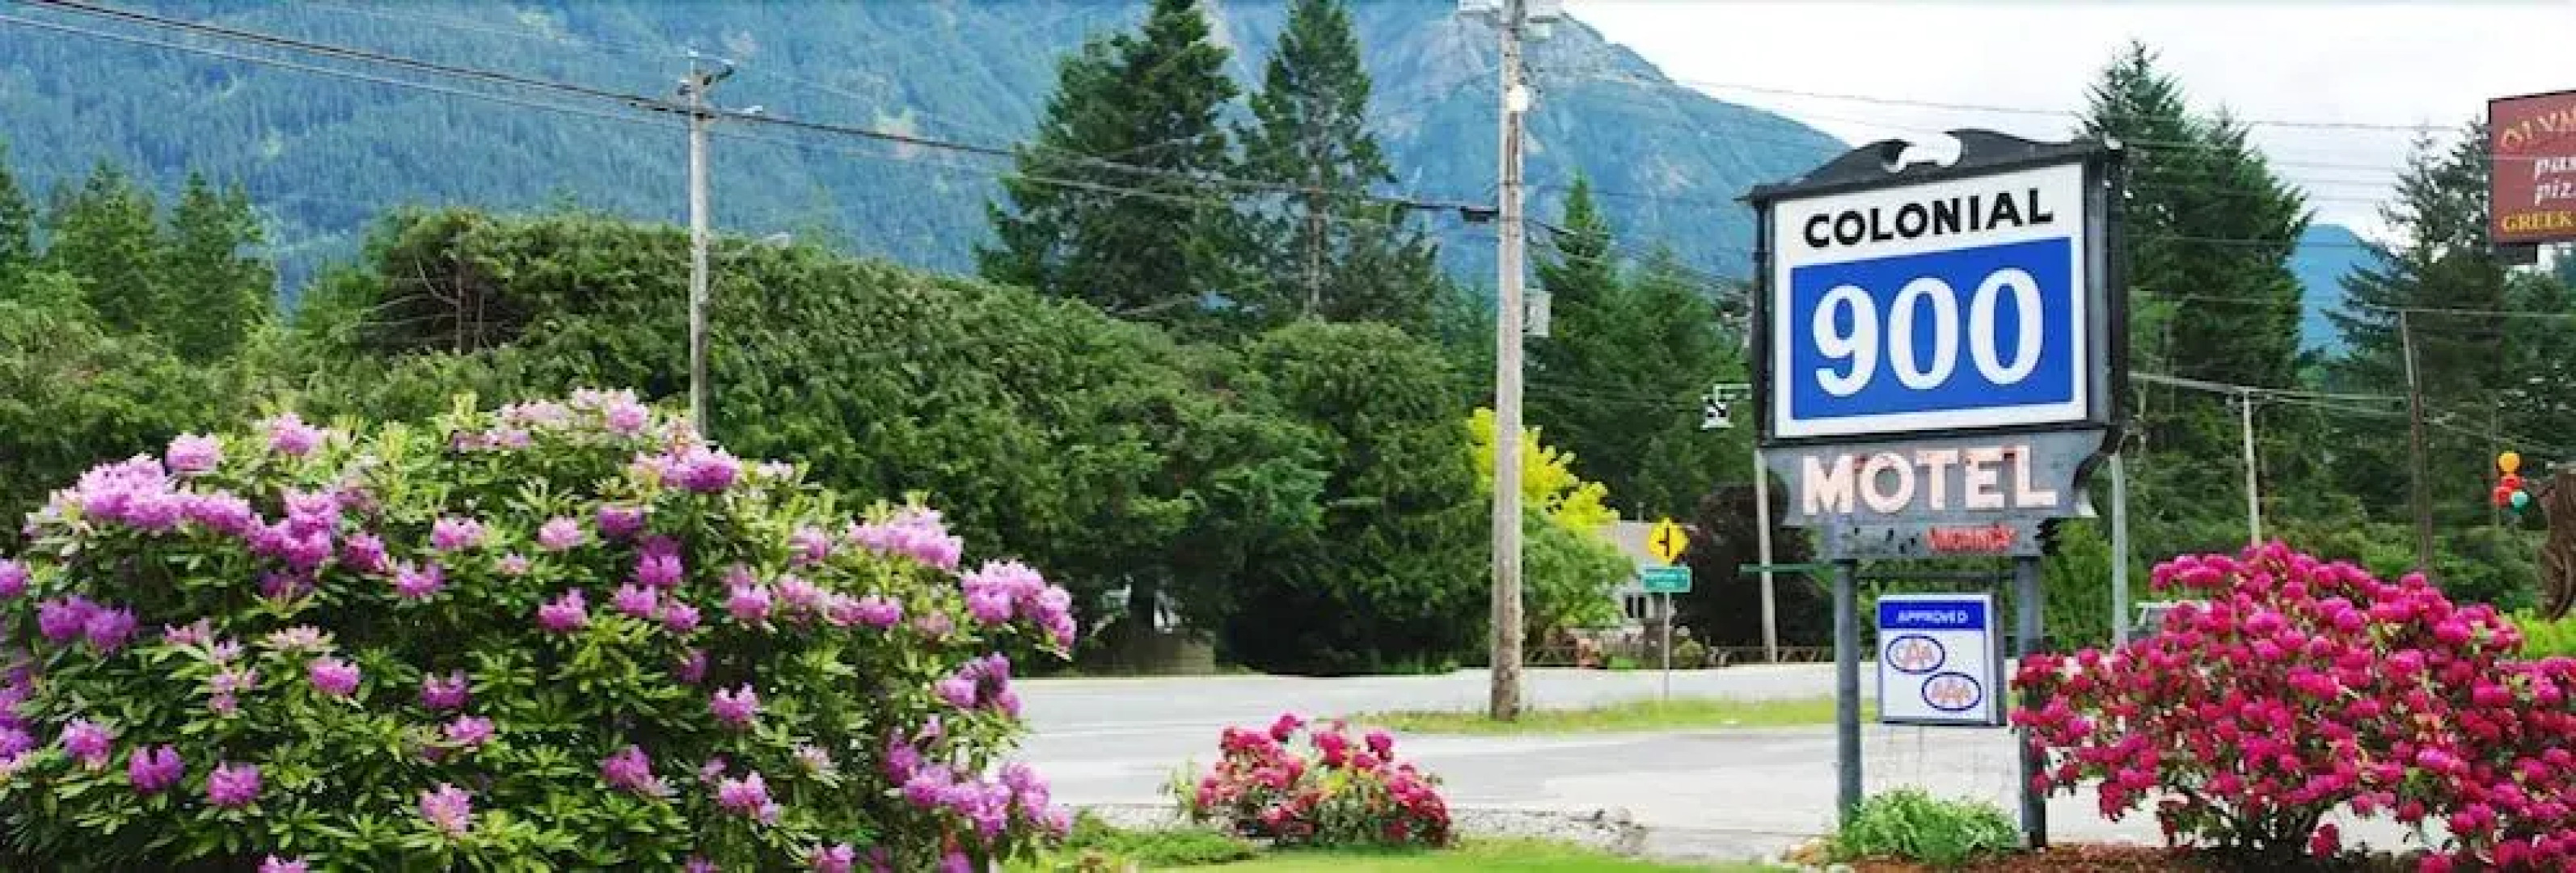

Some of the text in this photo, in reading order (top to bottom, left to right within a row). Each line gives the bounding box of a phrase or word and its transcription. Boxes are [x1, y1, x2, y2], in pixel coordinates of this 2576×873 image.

[1803, 188, 2054, 249] COLONIAL
[2500, 211, 2574, 233] GREEK
[1812, 267, 2044, 398] 900
[1801, 445, 2058, 516] MOTEL
[1896, 609, 1969, 624] APPROVED
